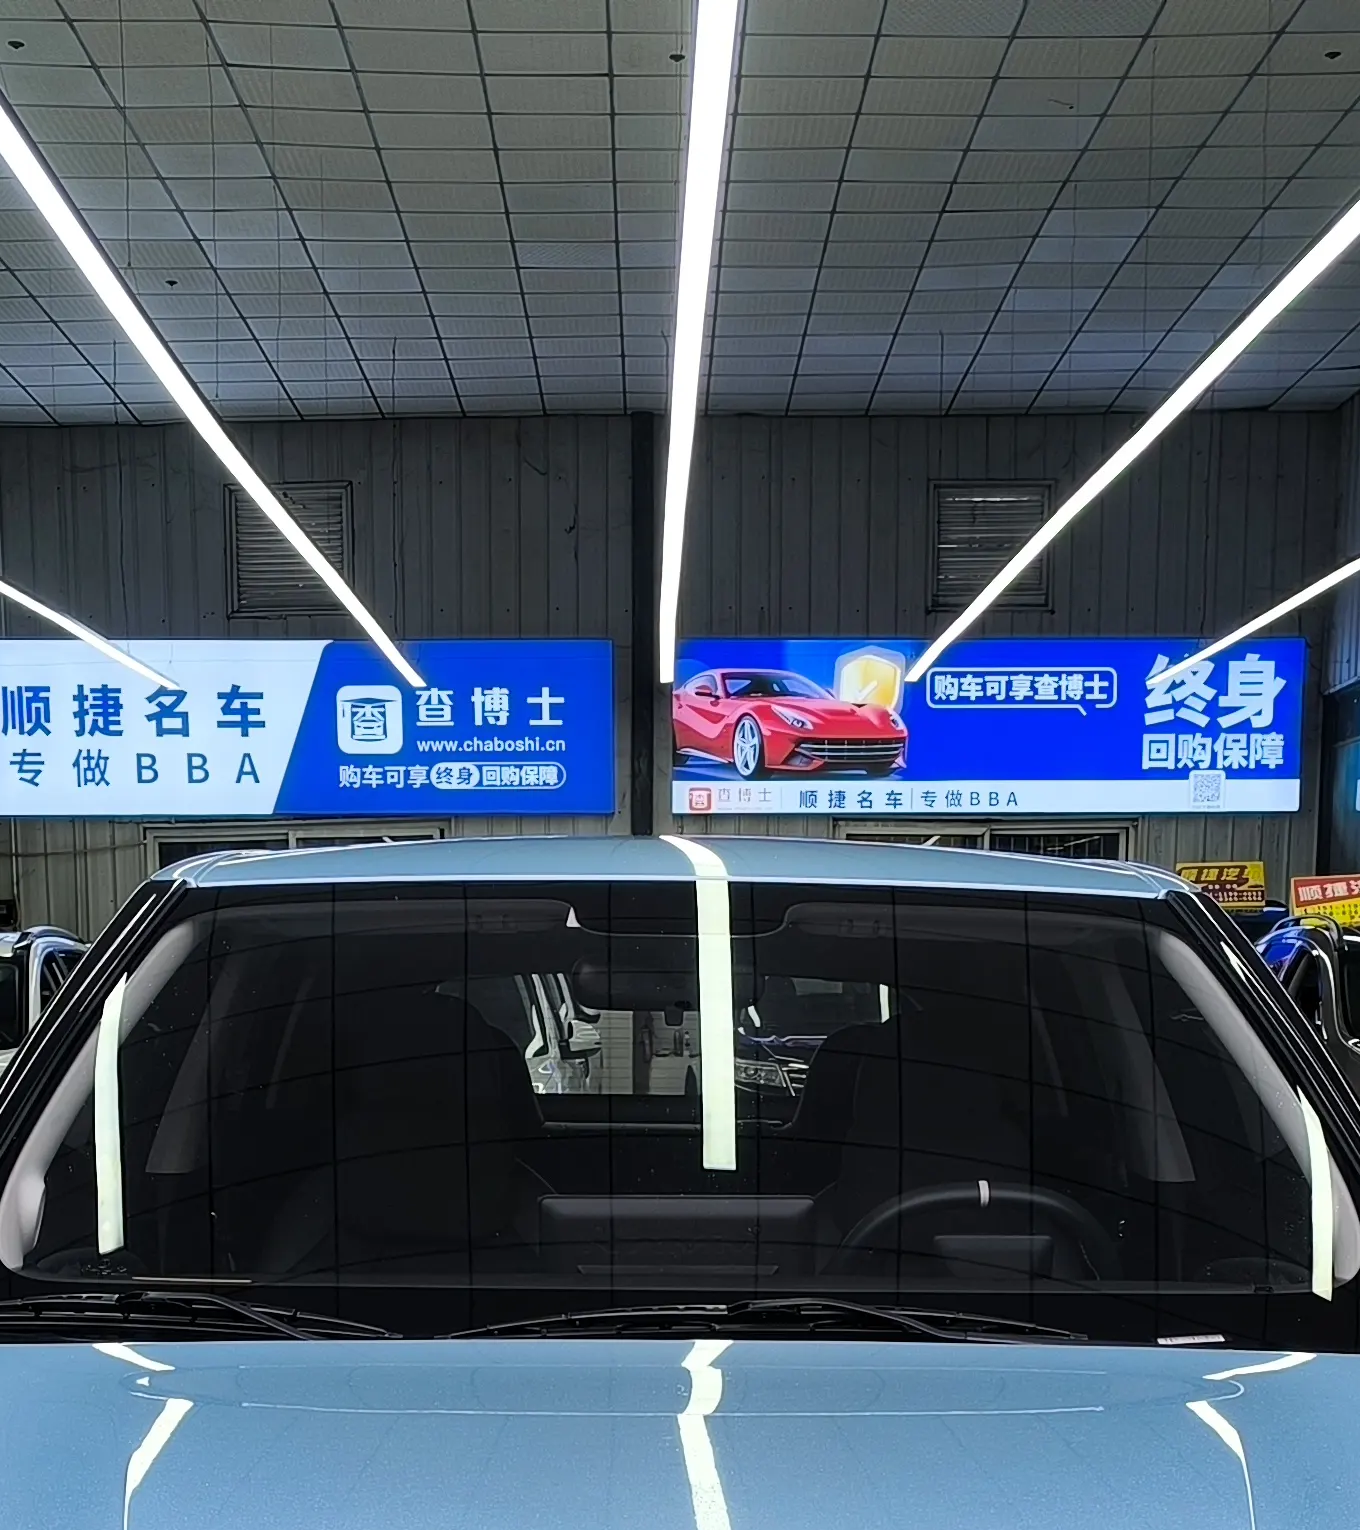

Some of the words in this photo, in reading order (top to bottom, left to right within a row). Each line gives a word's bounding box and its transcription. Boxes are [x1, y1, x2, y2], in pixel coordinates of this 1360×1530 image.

[416, 686, 565, 727] 查博士
[933, 674, 1110, 703] 购车可享查博士
[1143, 651, 1287, 729] 终身
[1, 683, 267, 738] 顺捷名车
[416, 737, 566, 752] www.chaboshi.cn
[1141, 732, 1285, 771] 回购保障
[9, 750, 260, 788] 专做BBA
[799, 789, 903, 809] 顺捷名车
[921, 789, 1019, 809] 专做BBA
